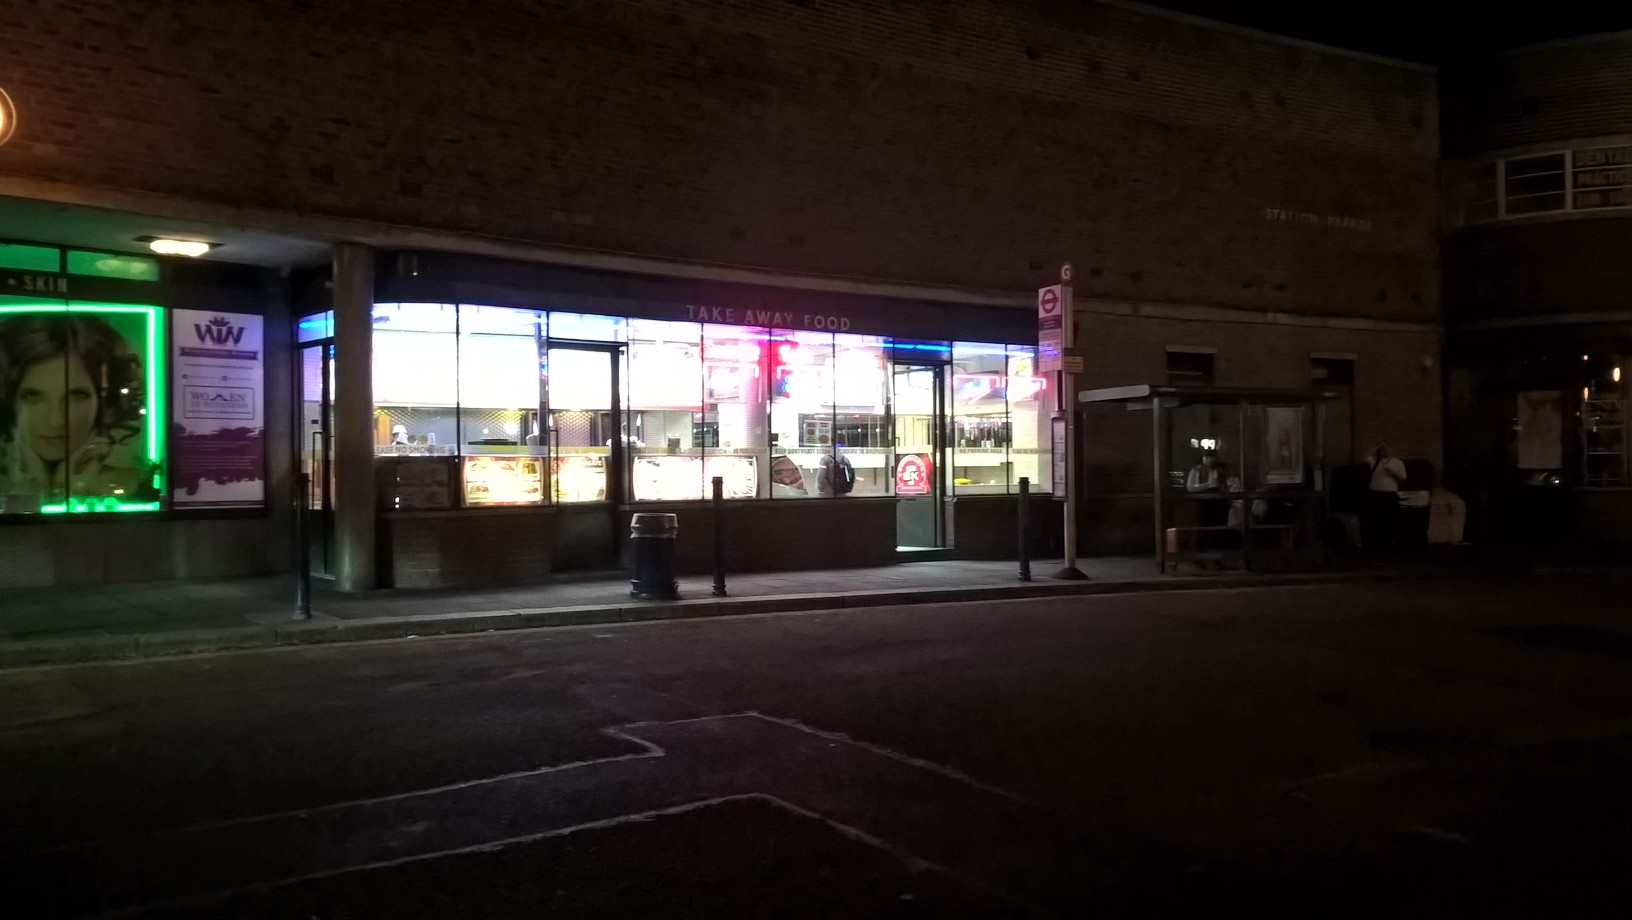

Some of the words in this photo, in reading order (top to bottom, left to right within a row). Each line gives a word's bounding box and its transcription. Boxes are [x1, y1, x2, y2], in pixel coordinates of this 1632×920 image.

[1265, 208, 1318, 224] STATION
[1061, 264, 1071, 280] G
[22, 275, 67, 293] SKIN
[686, 304, 735, 322] TAKE
[744, 309, 793, 326] AWAY
[804, 314, 851, 331] FOOD
[395, 446, 407, 454] NO
[408, 446, 446, 454] SMOKING
